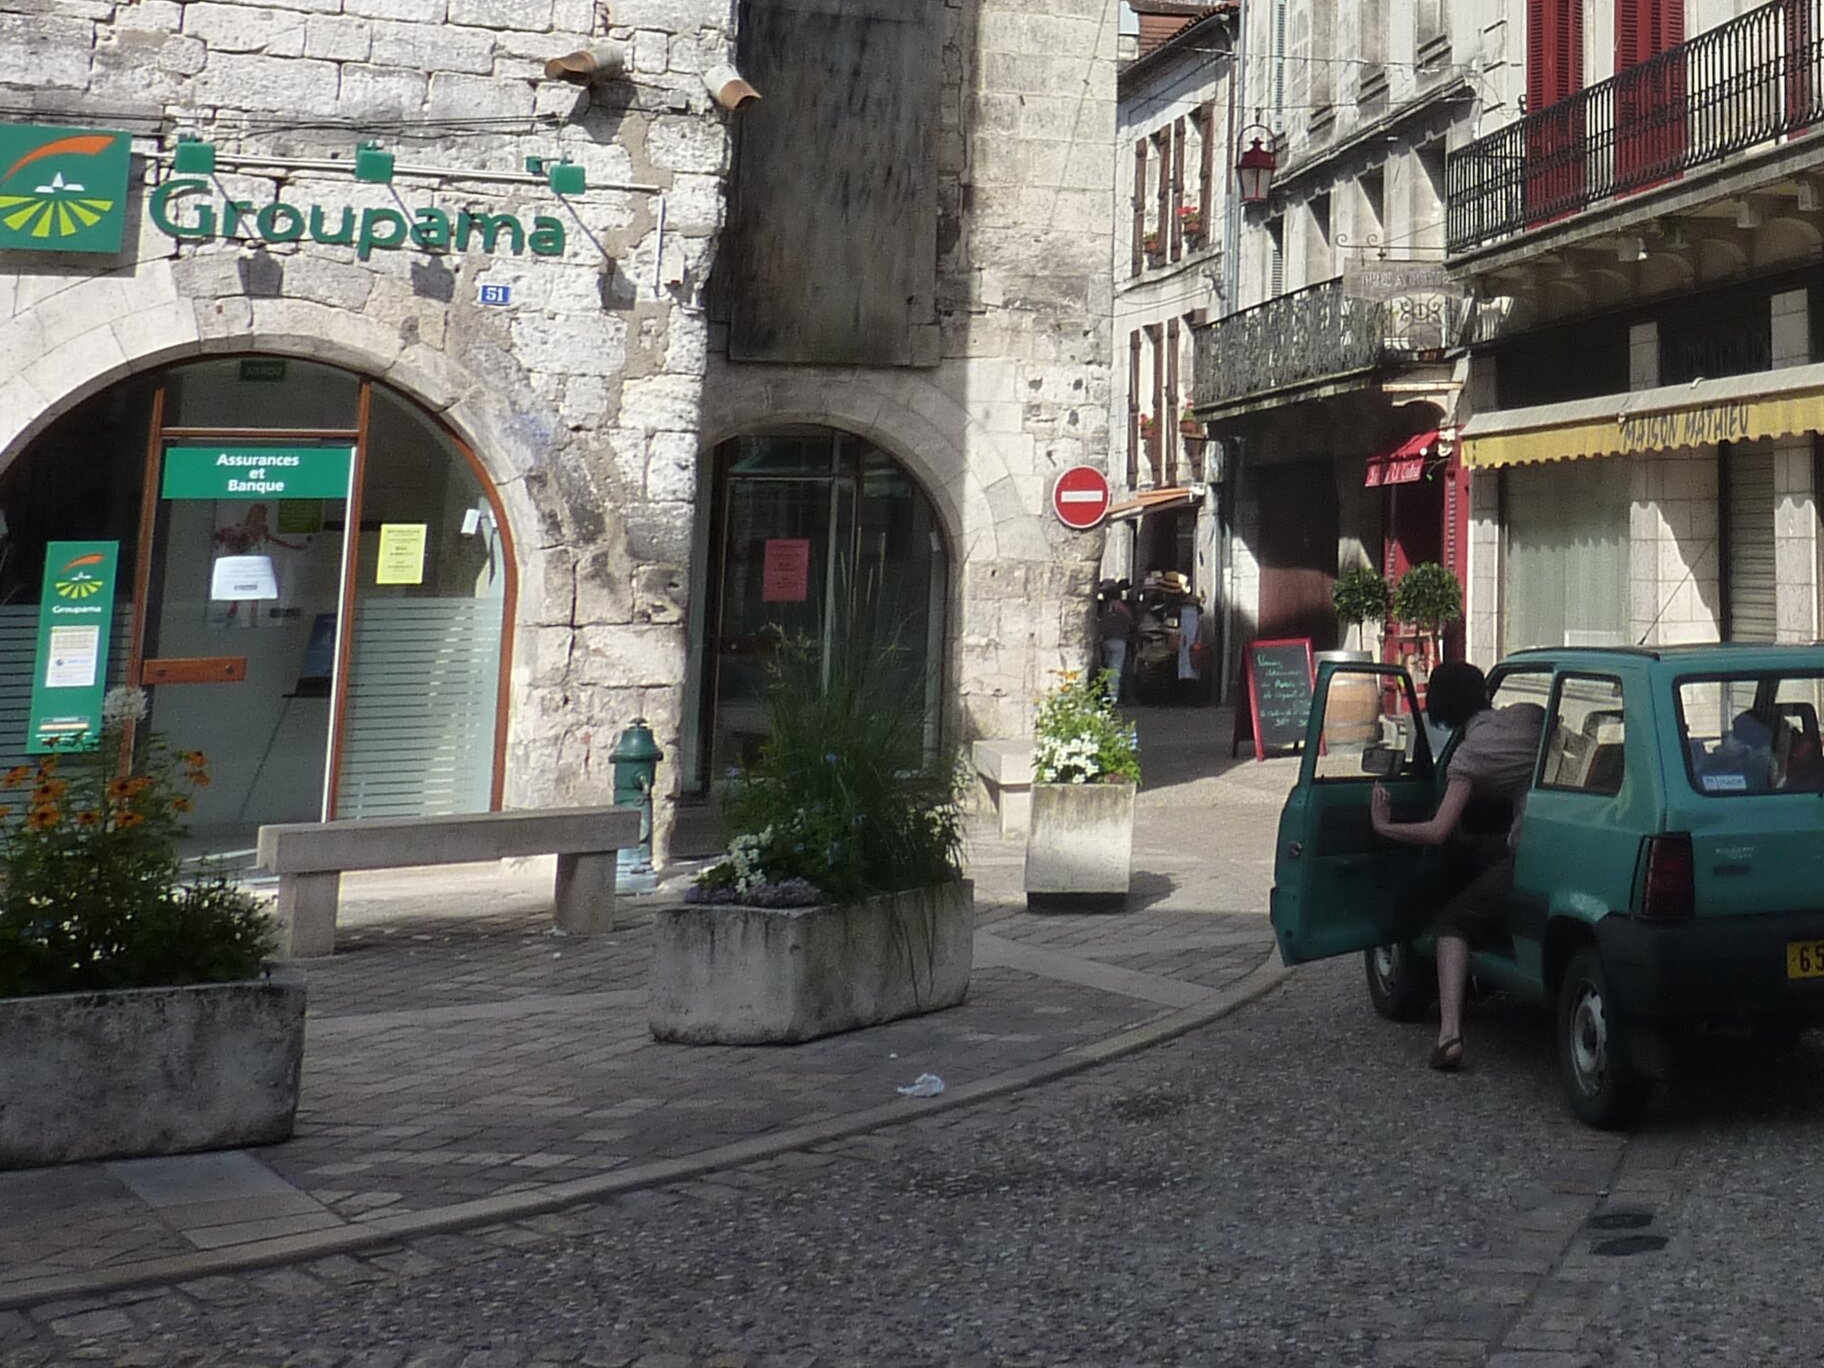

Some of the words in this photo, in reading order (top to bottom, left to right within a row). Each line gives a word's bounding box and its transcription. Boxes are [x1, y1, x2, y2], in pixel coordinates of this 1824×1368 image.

[149, 178, 566, 261] Groupama
[485, 287, 503, 302] 51
[1621, 414, 1677, 449] MAISON
[1684, 404, 1749, 446] MATHIEU
[216, 453, 300, 466] Assurances
[248, 467, 266, 479] et
[227, 479, 285, 494] Banque
